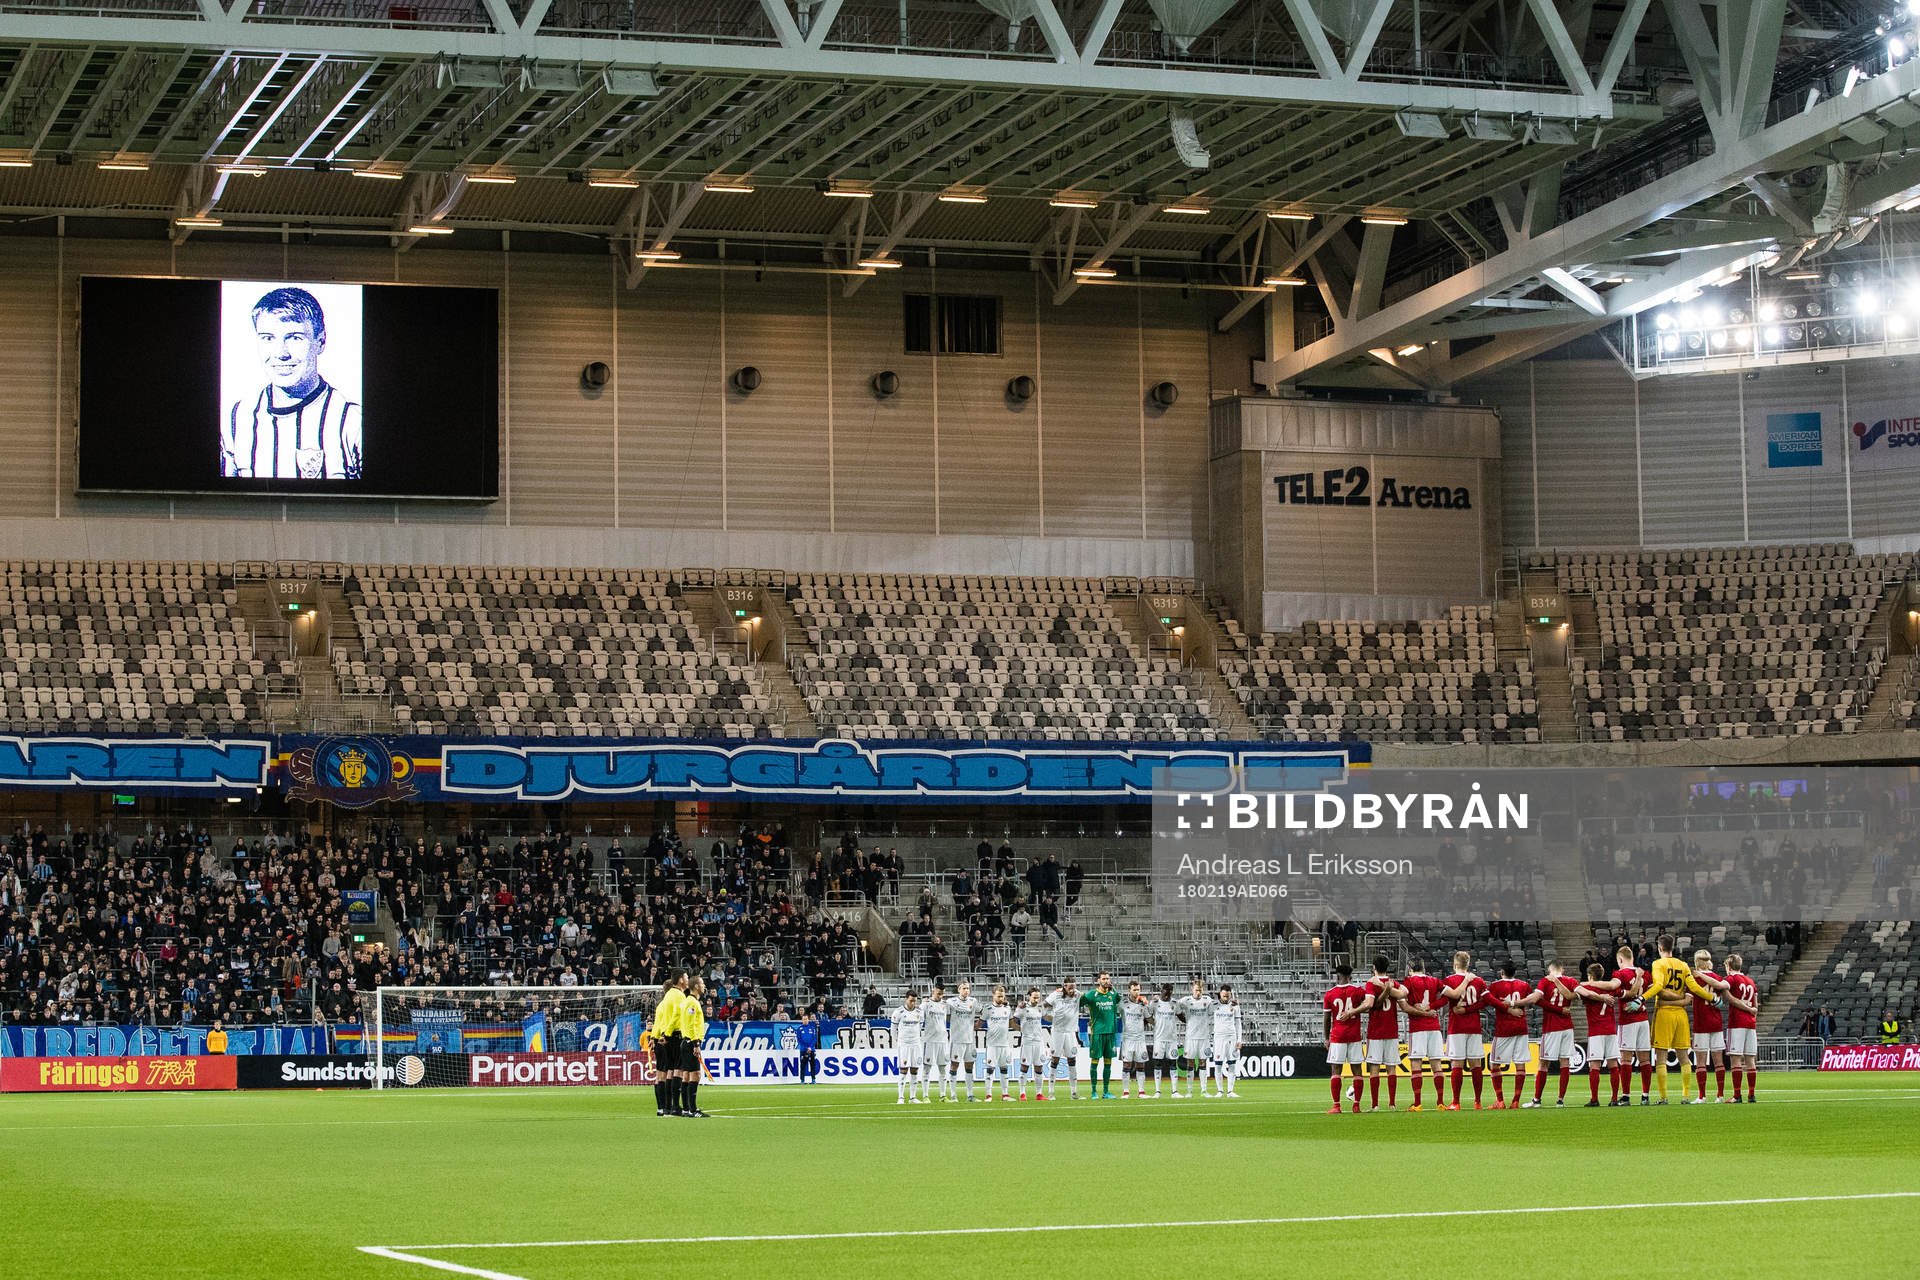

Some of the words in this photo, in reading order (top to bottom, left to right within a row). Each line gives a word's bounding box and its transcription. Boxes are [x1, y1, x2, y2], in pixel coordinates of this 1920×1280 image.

[1768, 431, 1819, 441] AMERICAN
[1779, 442, 1822, 452] EXPRESS
[1273, 466, 1370, 506] TELE2
[1377, 478, 1471, 509] Arena
[280, 583, 307, 593] B317
[728, 591, 753, 600] B316
[1154, 598, 1178, 609] B315
[1531, 598, 1557, 608] B314
[442, 738, 1236, 800] DJURGÅRDENS
[1665, 968, 1683, 991] 25
[1821, 1049, 1867, 1069] Prioritet
[1866, 1048, 1900, 1069] Finans
[40, 1061, 139, 1087] Färingsö
[146, 1060, 197, 1085] TRÄ
[281, 1061, 394, 1081] Sundström
[471, 1056, 599, 1083] Prioritet
